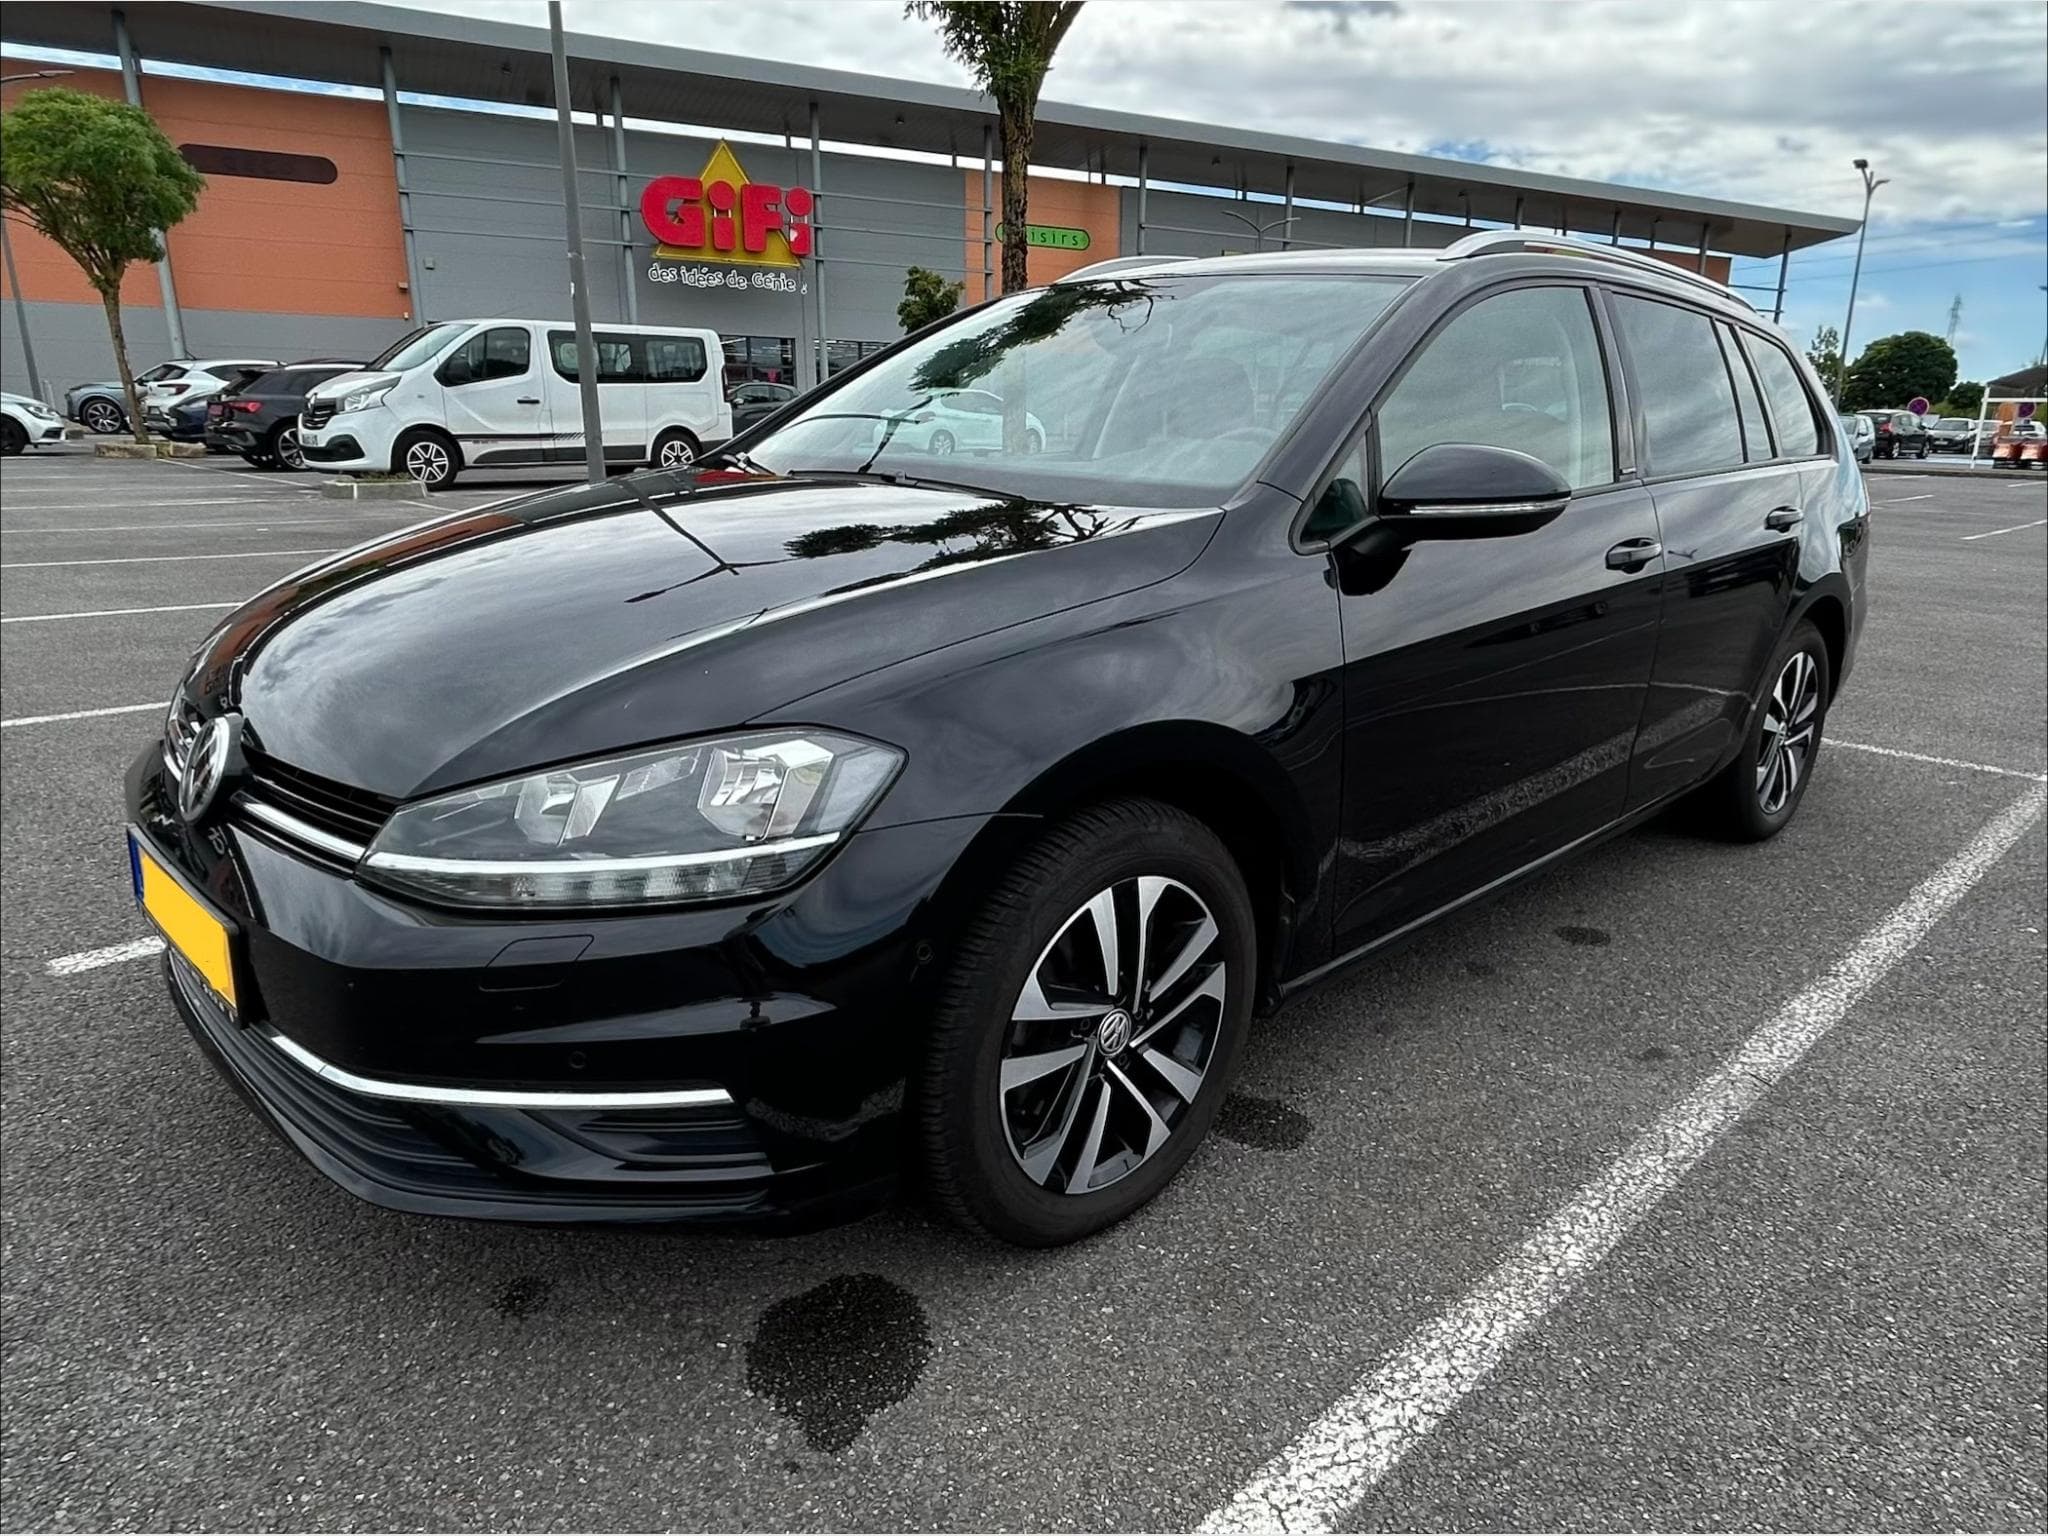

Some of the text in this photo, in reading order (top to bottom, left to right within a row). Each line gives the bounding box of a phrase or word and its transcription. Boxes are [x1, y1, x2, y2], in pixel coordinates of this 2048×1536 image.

[641, 175, 813, 256] GiFi
[1030, 228, 1079, 246] isirs
[648, 263, 677, 283] des
[680, 266, 725, 288] idées
[725, 270, 748, 289] de
[751, 272, 797, 293] Génie
